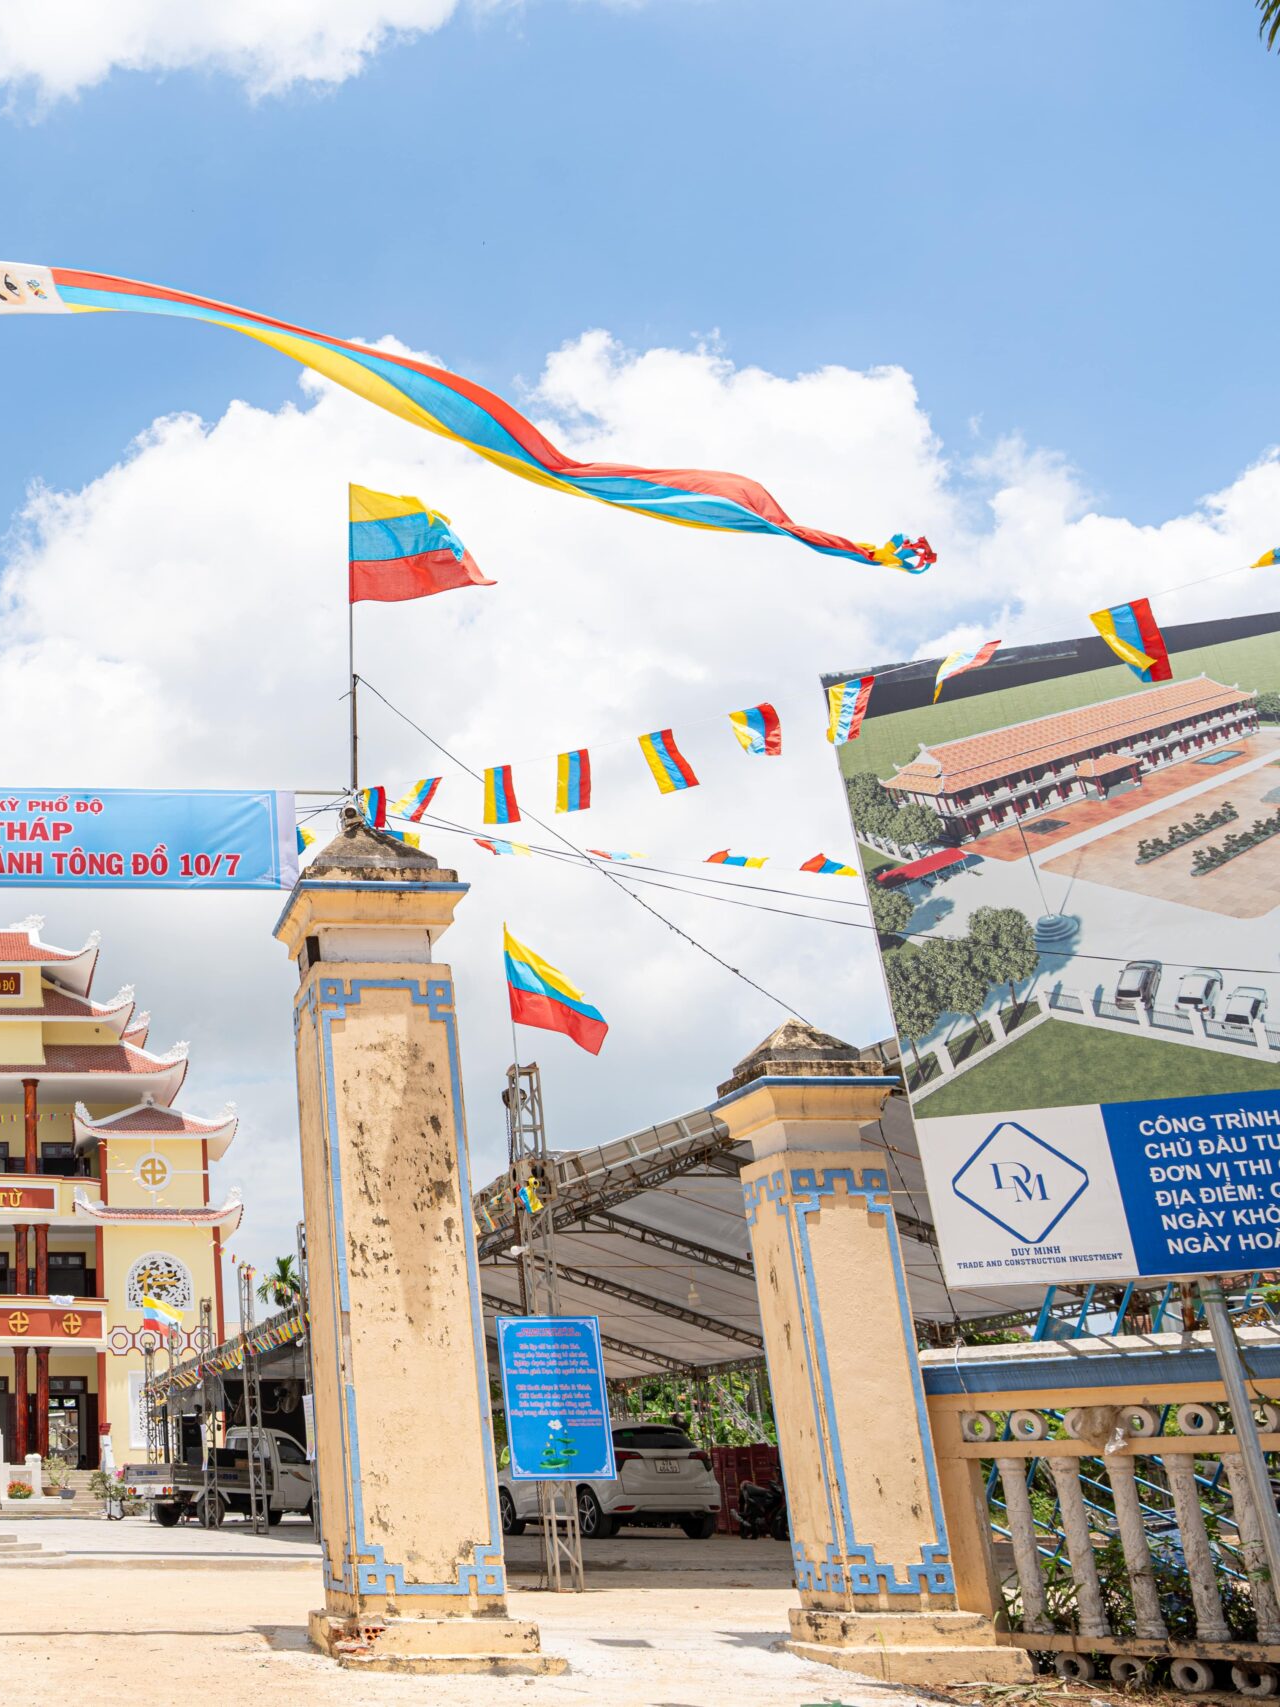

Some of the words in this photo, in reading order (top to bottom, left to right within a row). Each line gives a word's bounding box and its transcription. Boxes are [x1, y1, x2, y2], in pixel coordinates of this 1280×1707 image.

[28, 795, 68, 812] PHỔ
[75, 798, 103, 814] ĐỘ
[52, 847, 123, 875] TÔNG
[131, 844, 169, 875] ĐỒ
[180, 854, 241, 876] 10/7
[1139, 1115, 1206, 1136] CÔNG
[1144, 1137, 1193, 1159] CHỦ
[1198, 1134, 1248, 1156] ĐẦU
[1149, 1163, 1202, 1183] ĐƠN
[1205, 1161, 1231, 1182] VỊ
[1233, 1158, 1273, 1176] THI
[1154, 1188, 1197, 1209] ĐỊA
[1199, 1181, 1264, 1204] ĐIỂM:
[1161, 1208, 1226, 1231] NGÀY
[1011, 1247, 1032, 1257] DUY
[1034, 1245, 1061, 1255] MINH
[1167, 1232, 1232, 1255] NGÀY
[957, 1260, 984, 1270] TRADE
[986, 1259, 1003, 1268] AND
[1004, 1255, 1067, 1267] CONSTRUCTION
[1069, 1252, 1123, 1263] INVESTMENT
